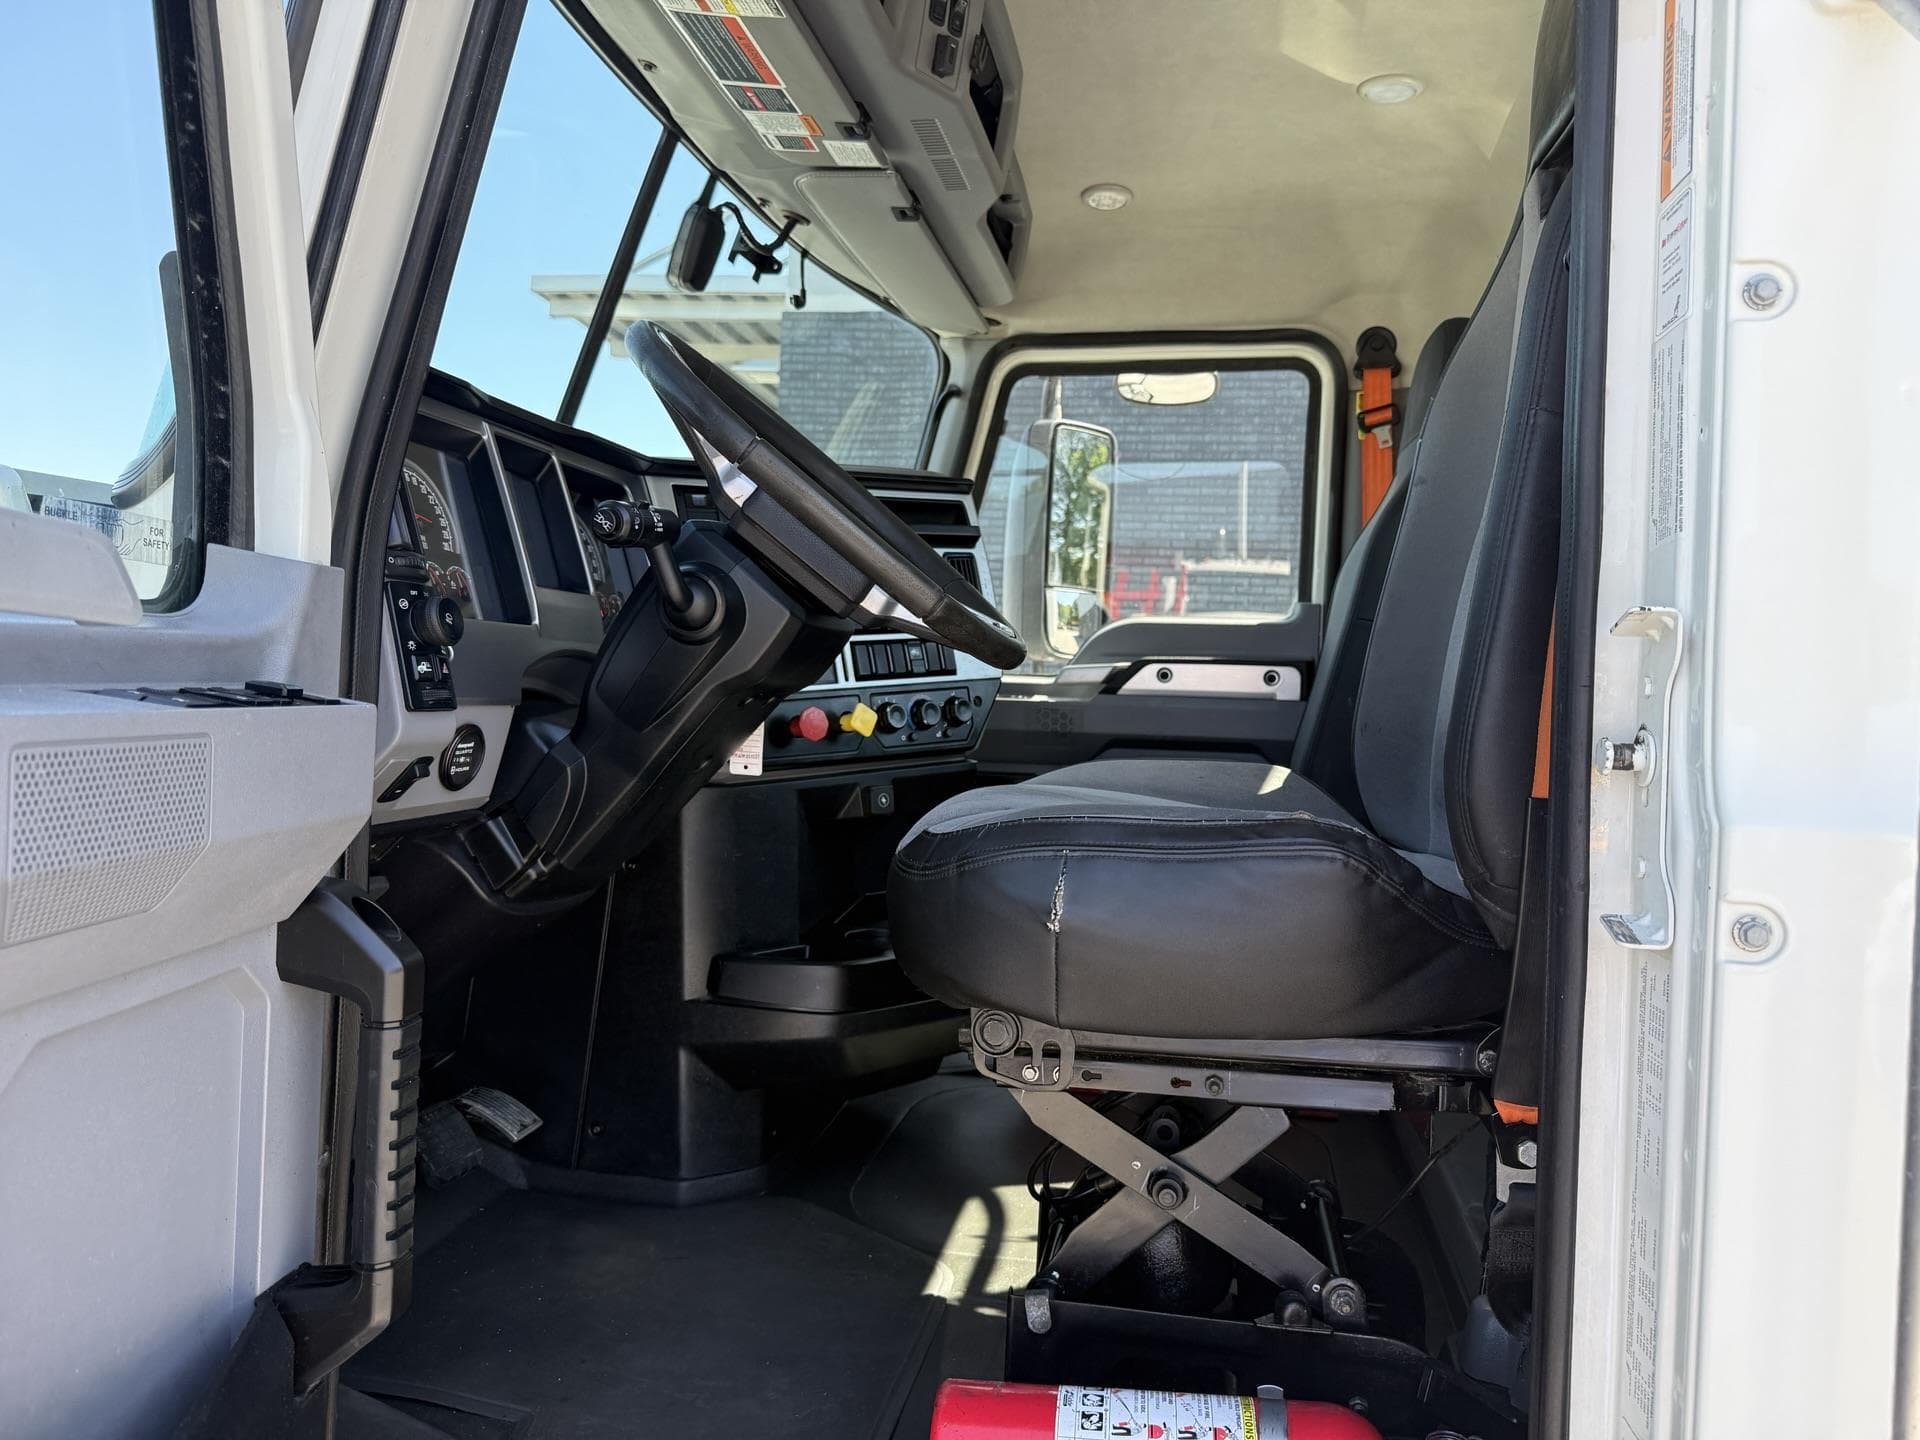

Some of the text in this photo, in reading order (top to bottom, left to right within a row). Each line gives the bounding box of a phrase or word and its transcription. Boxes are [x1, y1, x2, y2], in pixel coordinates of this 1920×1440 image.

[1663, 23, 1674, 142] WARNING
[44, 505, 79, 521] BUCKLE
[149, 526, 165, 538] FOR
[143, 537, 171, 552] SAFETY
